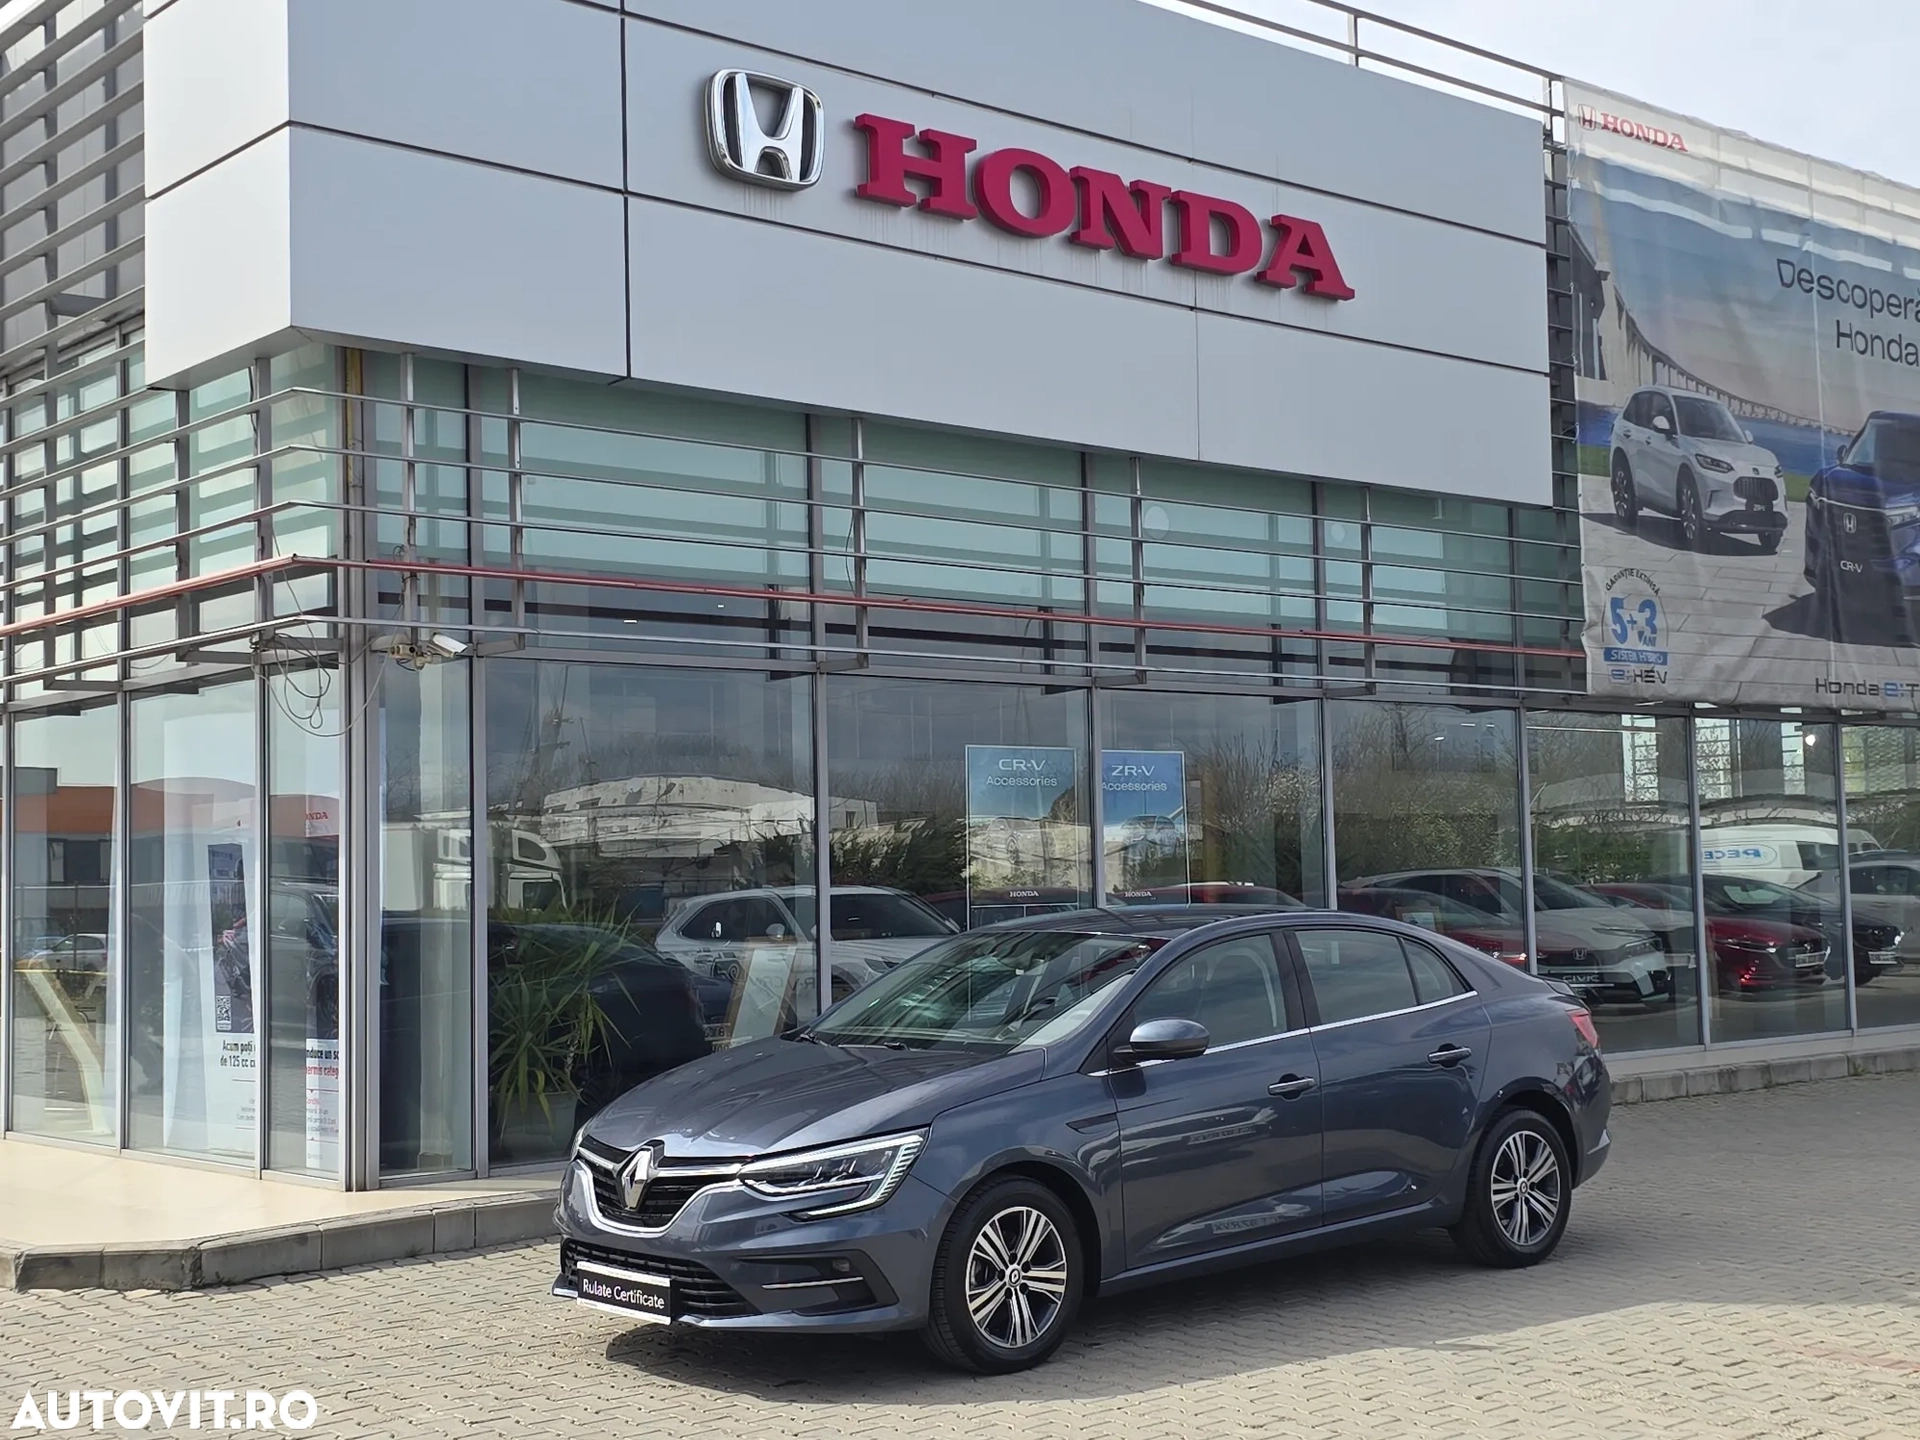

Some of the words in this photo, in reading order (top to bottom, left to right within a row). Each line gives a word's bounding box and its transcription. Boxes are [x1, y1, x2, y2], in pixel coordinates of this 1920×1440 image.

[1601, 112, 1688, 152] HONDA
[853, 112, 1355, 301] HONDA
[1835, 319, 1920, 368] Honda
[1840, 560, 1863, 573] CR-V
[1815, 677, 1880, 696] Honda
[998, 758, 1046, 771] CR-V
[1111, 765, 1155, 776] ZR-V
[986, 775, 1058, 787] Accessories
[1009, 890, 1039, 898] HONDA
[1124, 890, 1152, 898] HONDA
[1562, 974, 1600, 983] CIVIC
[582, 1278, 612, 1298] Rulate
[613, 1286, 665, 1309] Certificate
